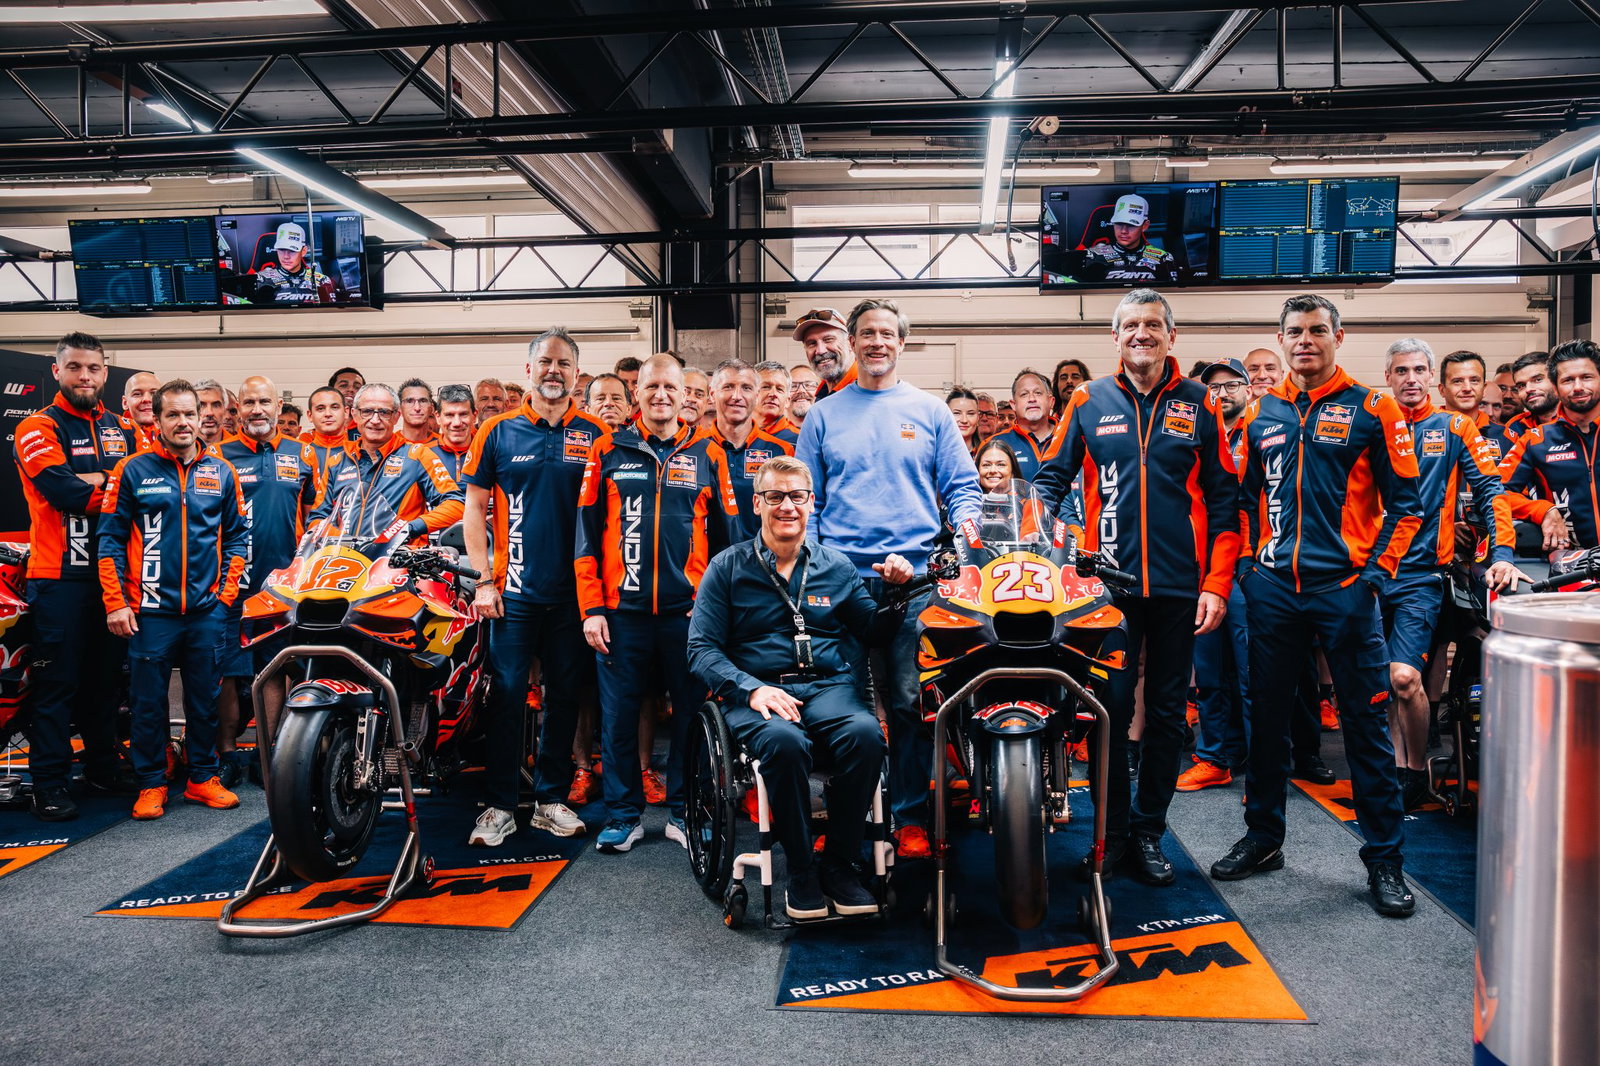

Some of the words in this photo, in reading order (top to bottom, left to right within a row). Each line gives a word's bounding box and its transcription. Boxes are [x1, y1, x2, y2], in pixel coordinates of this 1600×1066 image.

[4, 383, 36, 396] WP
[1100, 414, 1125, 423] WP
[1170, 421, 1190, 430] KTM
[1097, 426, 1127, 435] MOTUL
[1262, 424, 1284, 436] WP
[1321, 426, 1345, 434] KTM
[1262, 434, 1285, 448] MOTUL
[1547, 452, 1577, 462] MOTUL
[141, 477, 165, 485] WP
[70, 514, 90, 566] RAC
[505, 491, 524, 594] RACING
[624, 495, 643, 591] RACING
[295, 555, 368, 594] 12
[992, 561, 1055, 604] 23
[478, 854, 563, 865] KTM.COM
[119, 894, 197, 908] READY
[200, 891, 229, 901] TO
[297, 873, 533, 911] KTM
[1137, 913, 1226, 932] KTM.COM
[1014, 941, 1252, 989] KTM
[789, 979, 868, 998] READY
[871, 974, 907, 989] TO
